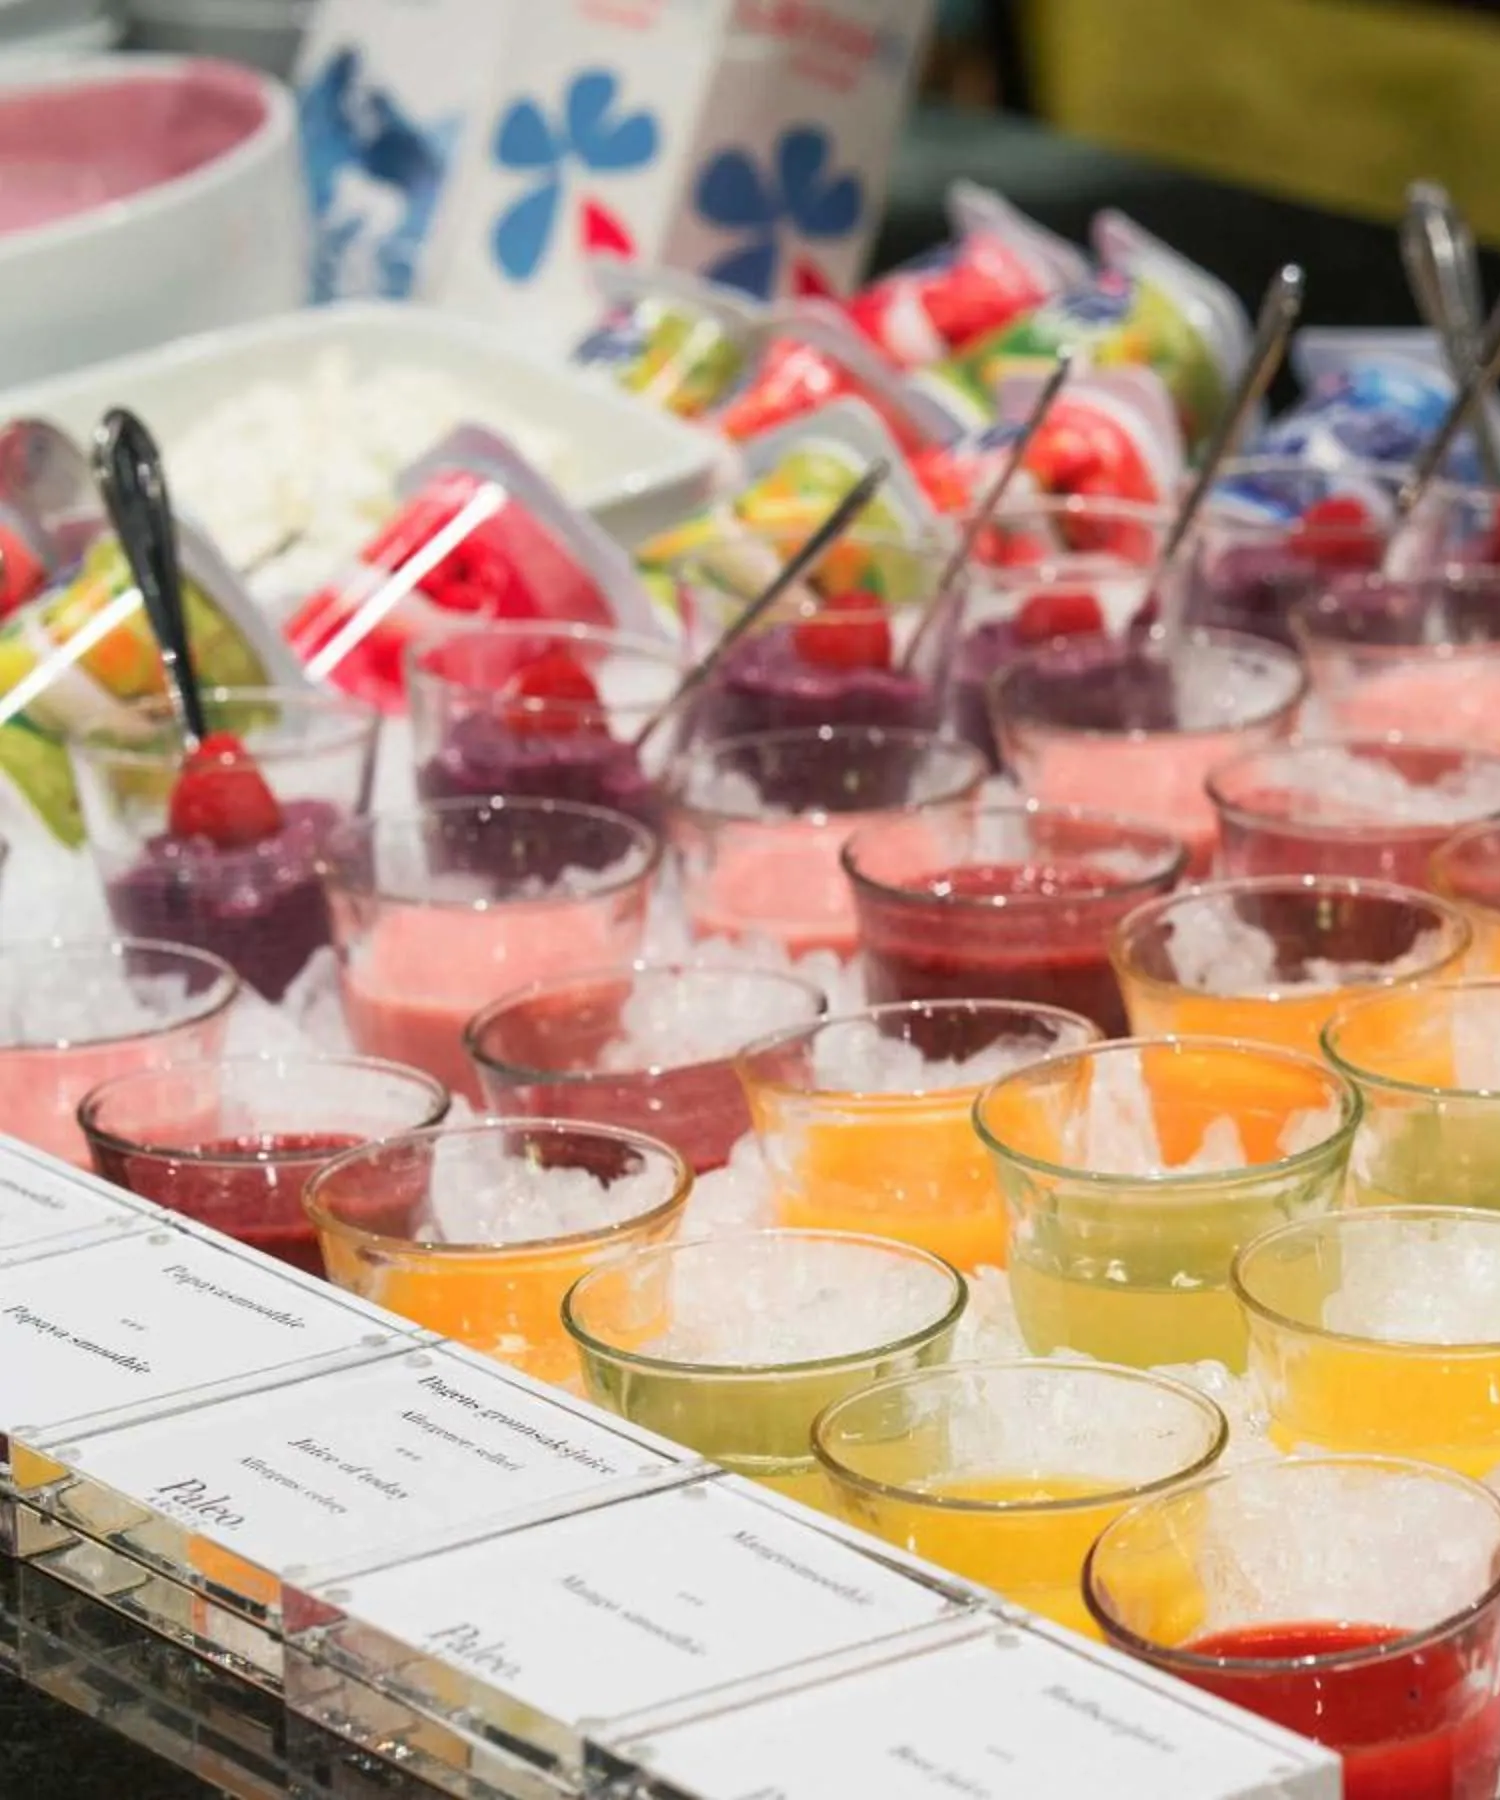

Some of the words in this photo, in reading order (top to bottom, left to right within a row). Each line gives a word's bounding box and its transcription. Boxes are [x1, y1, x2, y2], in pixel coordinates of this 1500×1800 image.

[162, 1264, 306, 1330] Papayasmoothie
[3, 1304, 69, 1339] Papaya
[68, 1336, 151, 1374] smoothie
[287, 1438, 340, 1463] Juice
[358, 1473, 408, 1500] today
